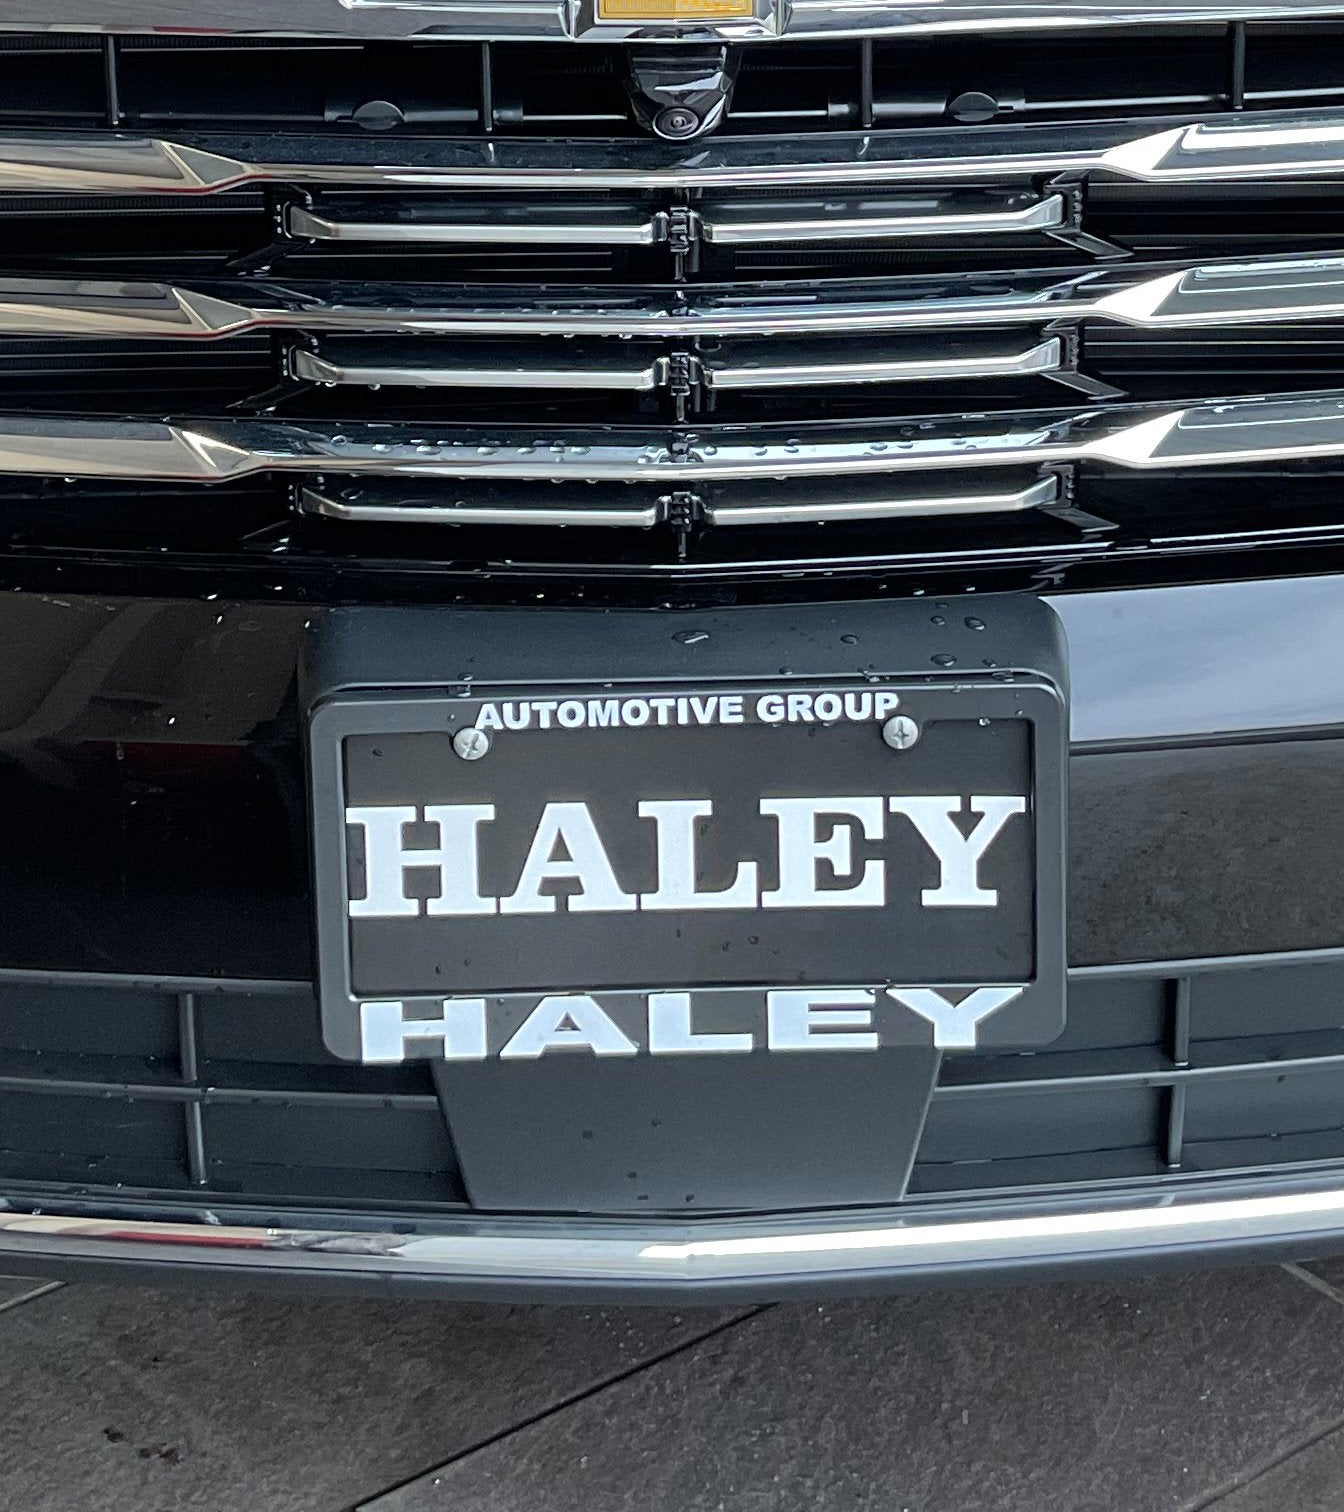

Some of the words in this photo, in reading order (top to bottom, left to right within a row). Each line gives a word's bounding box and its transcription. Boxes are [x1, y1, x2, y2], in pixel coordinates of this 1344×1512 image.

[474, 696, 744, 731] AUTOMOTIVE
[757, 691, 899, 722] GROUP
[346, 795, 1025, 918] HALEY
[359, 986, 1024, 1064] HALEY
